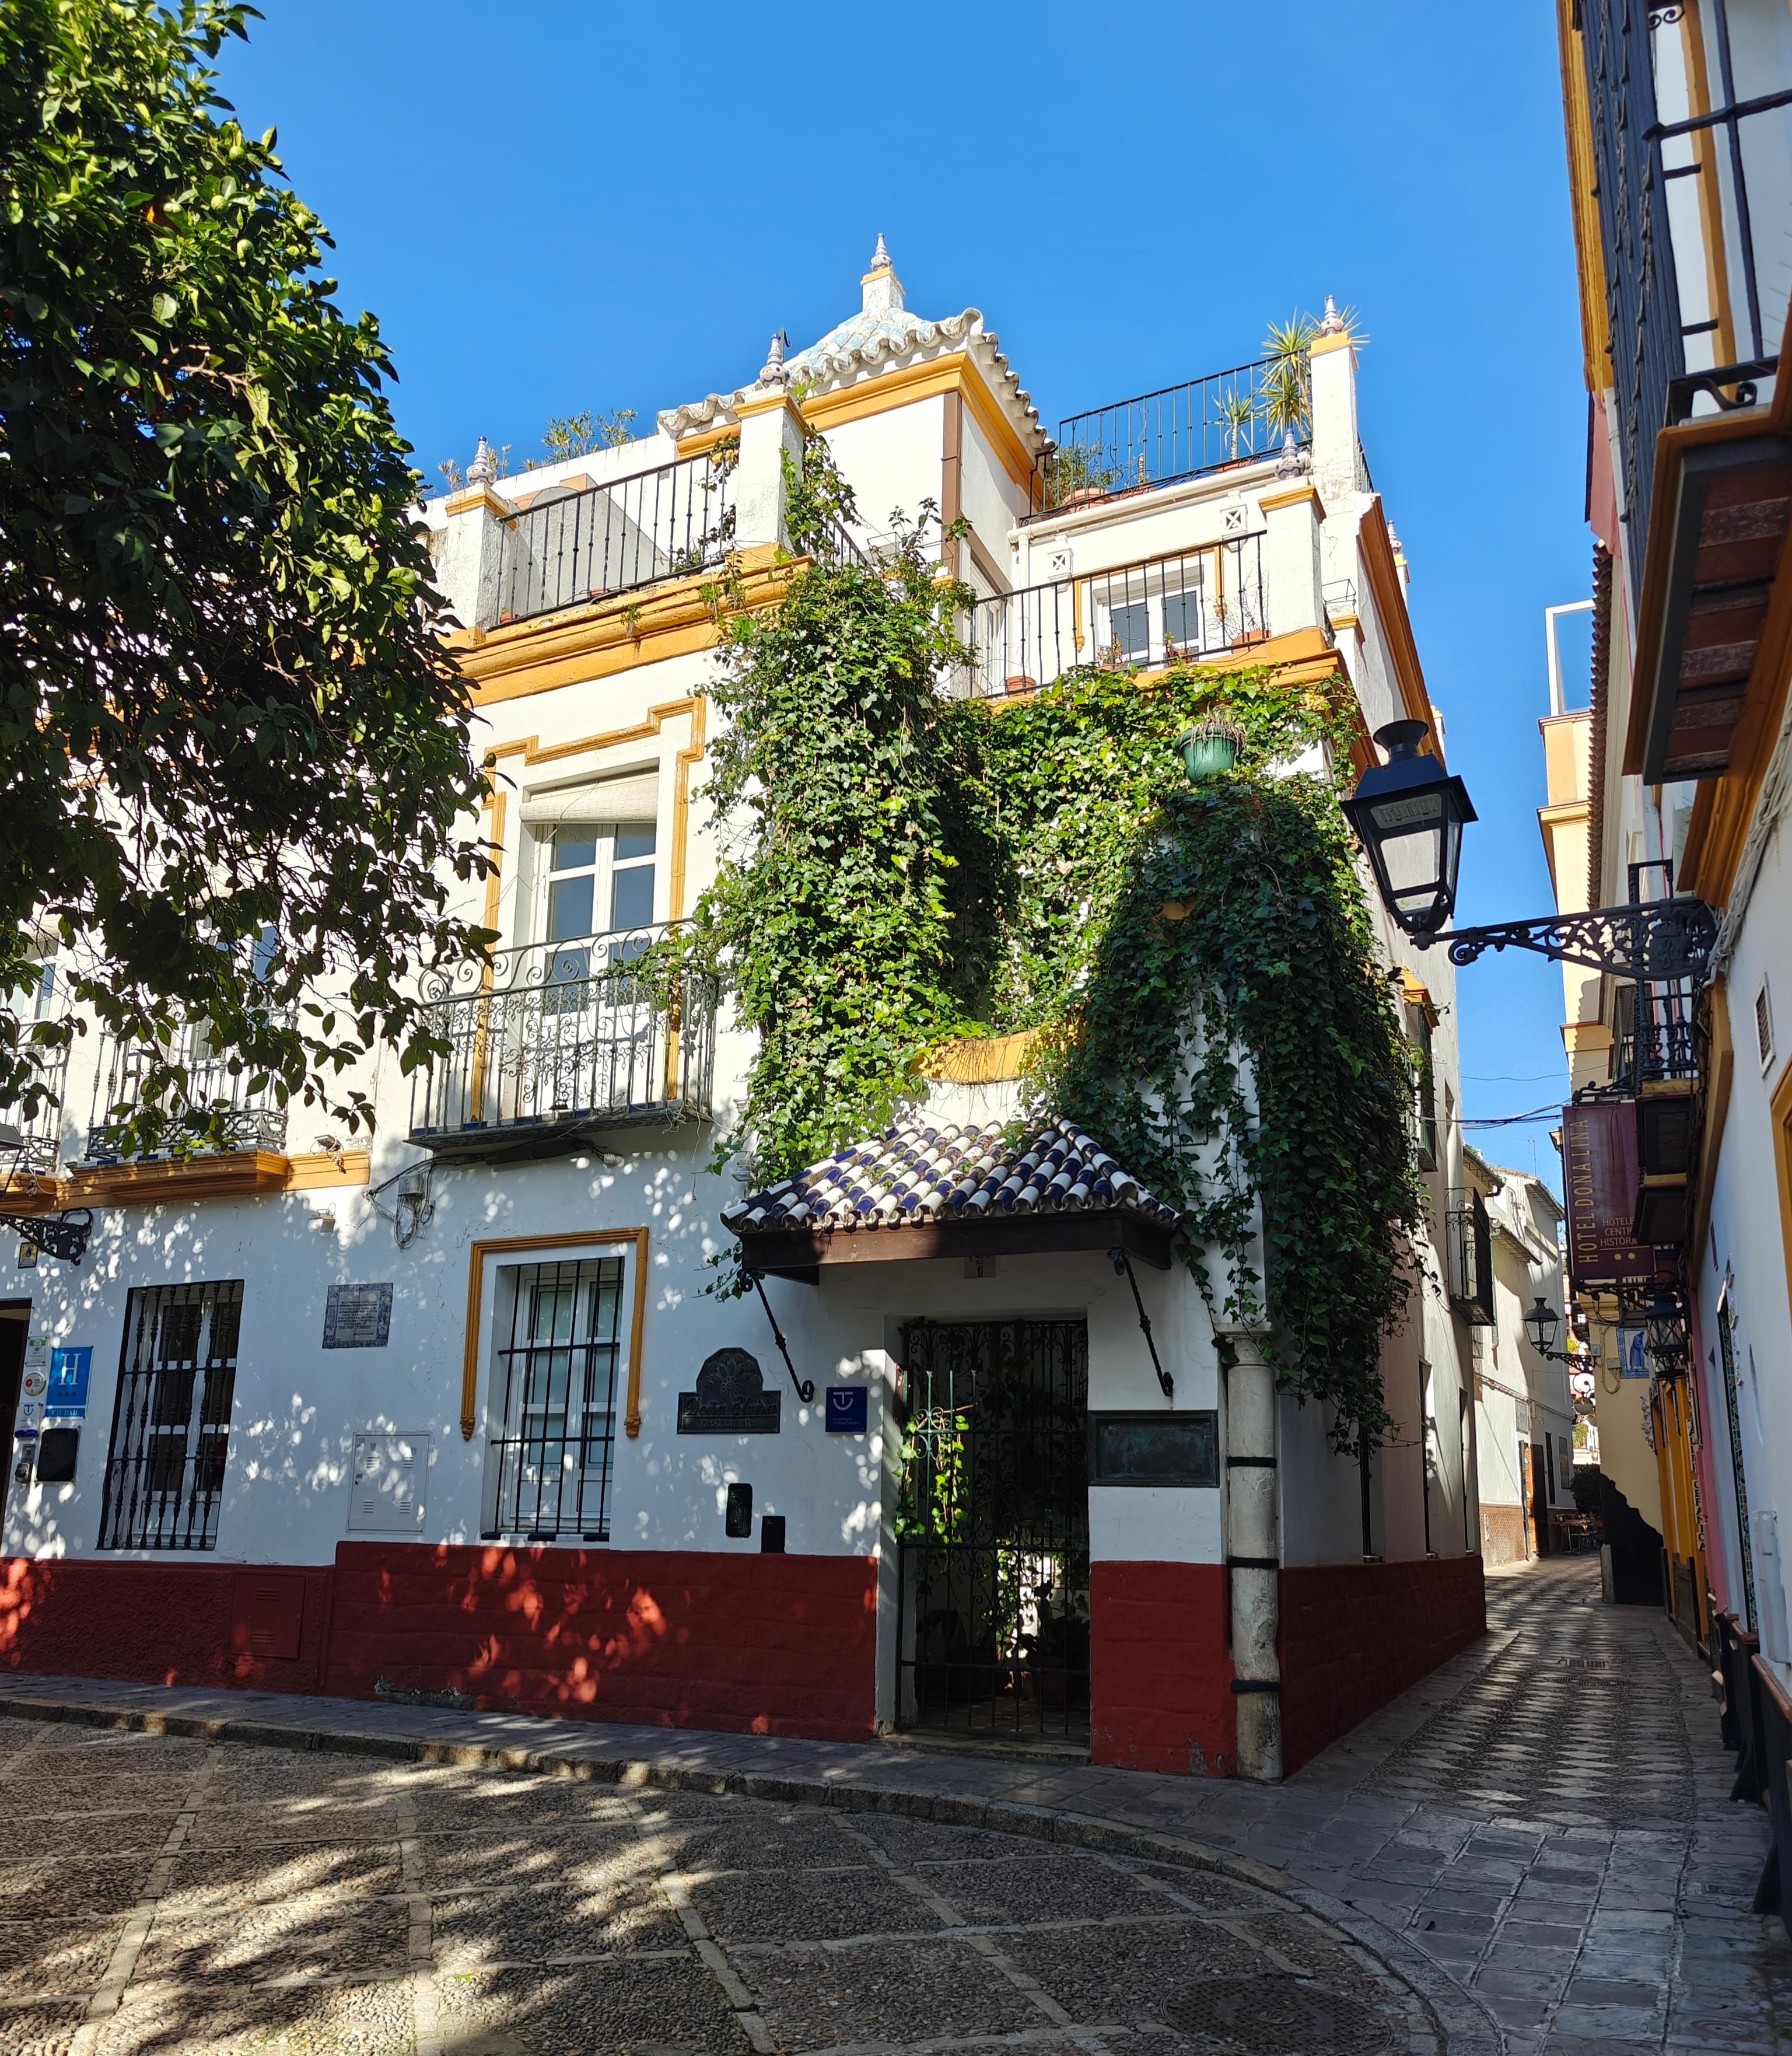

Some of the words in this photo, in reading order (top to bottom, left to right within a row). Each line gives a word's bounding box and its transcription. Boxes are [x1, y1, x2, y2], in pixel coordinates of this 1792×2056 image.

[1569, 1120, 1591, 1157] LINA
[1569, 1162, 1594, 1207] DOÑA
[1576, 1213, 1598, 1263] HOTEL
[1605, 1228, 1632, 1236] CENTR
[58, 1353, 81, 1385] H
[701, 1418, 756, 1429] restaurante
